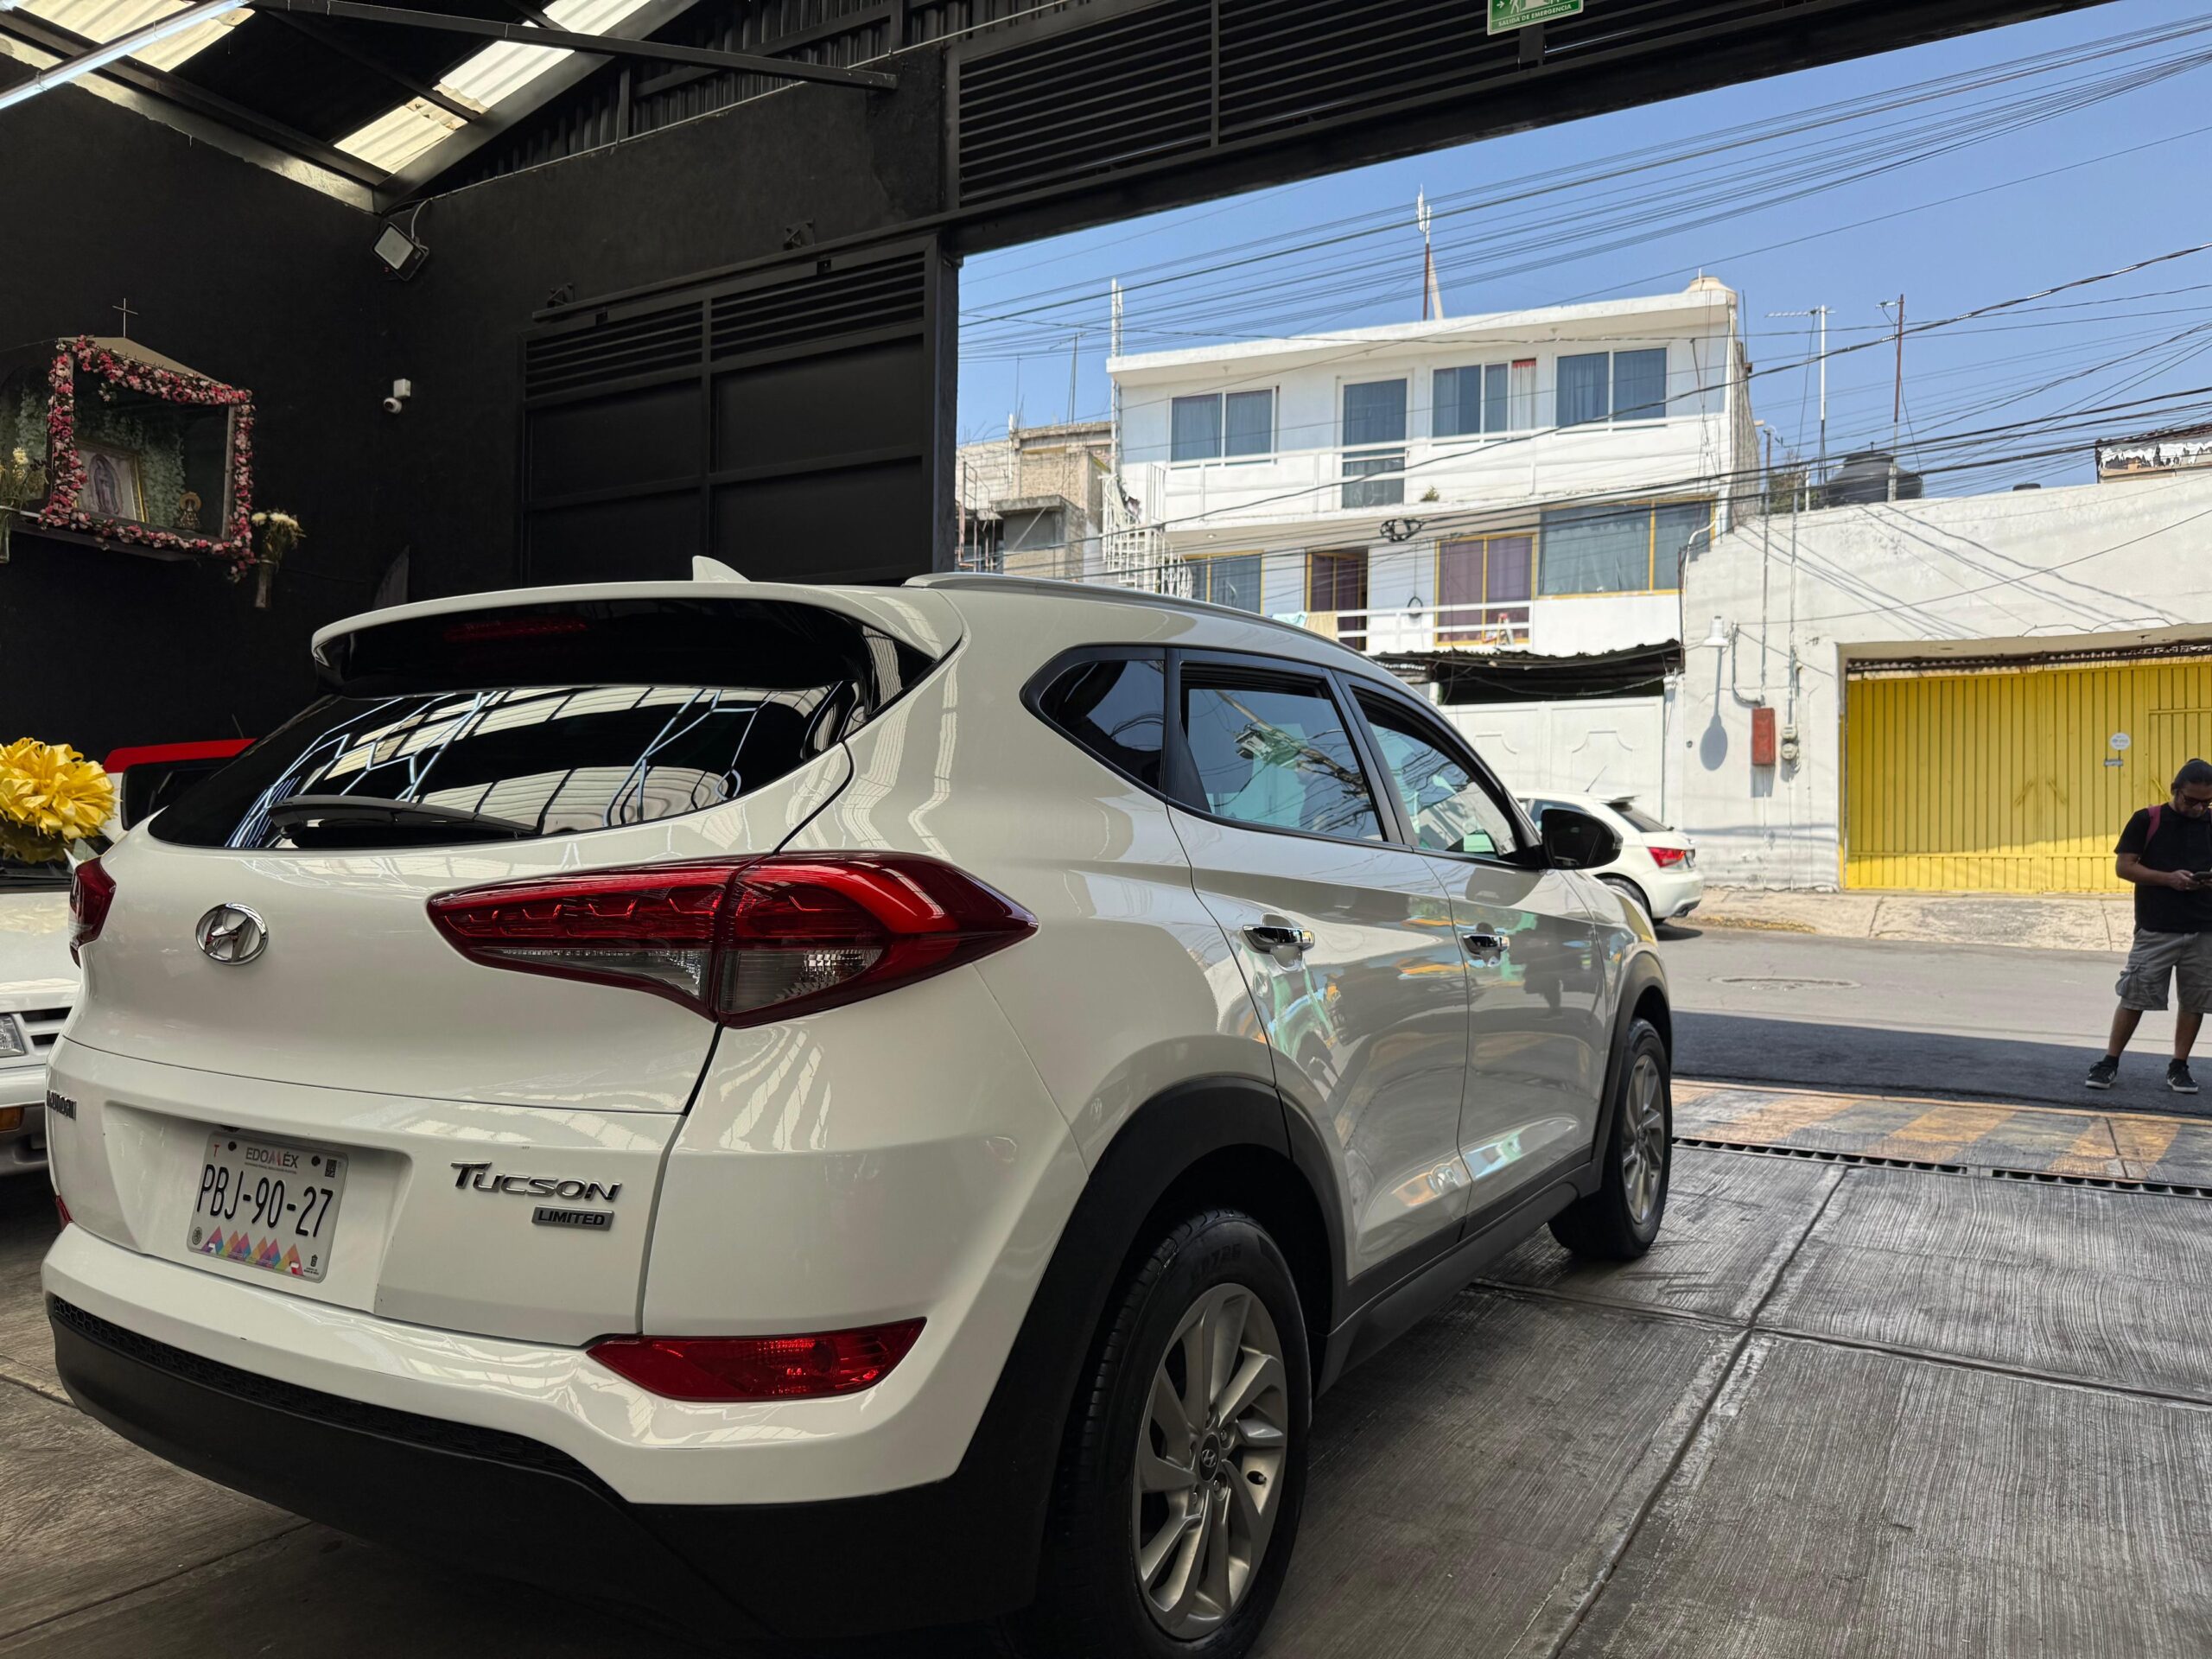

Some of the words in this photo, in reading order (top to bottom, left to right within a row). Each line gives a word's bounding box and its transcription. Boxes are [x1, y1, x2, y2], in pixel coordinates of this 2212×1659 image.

[1498, 16, 1521, 27] SALIDA
[1531, 3, 1573, 19] EMERGENCIA
[196, 1163, 334, 1238] PBJ-90-27
[537, 1210, 606, 1226] LIMITED
